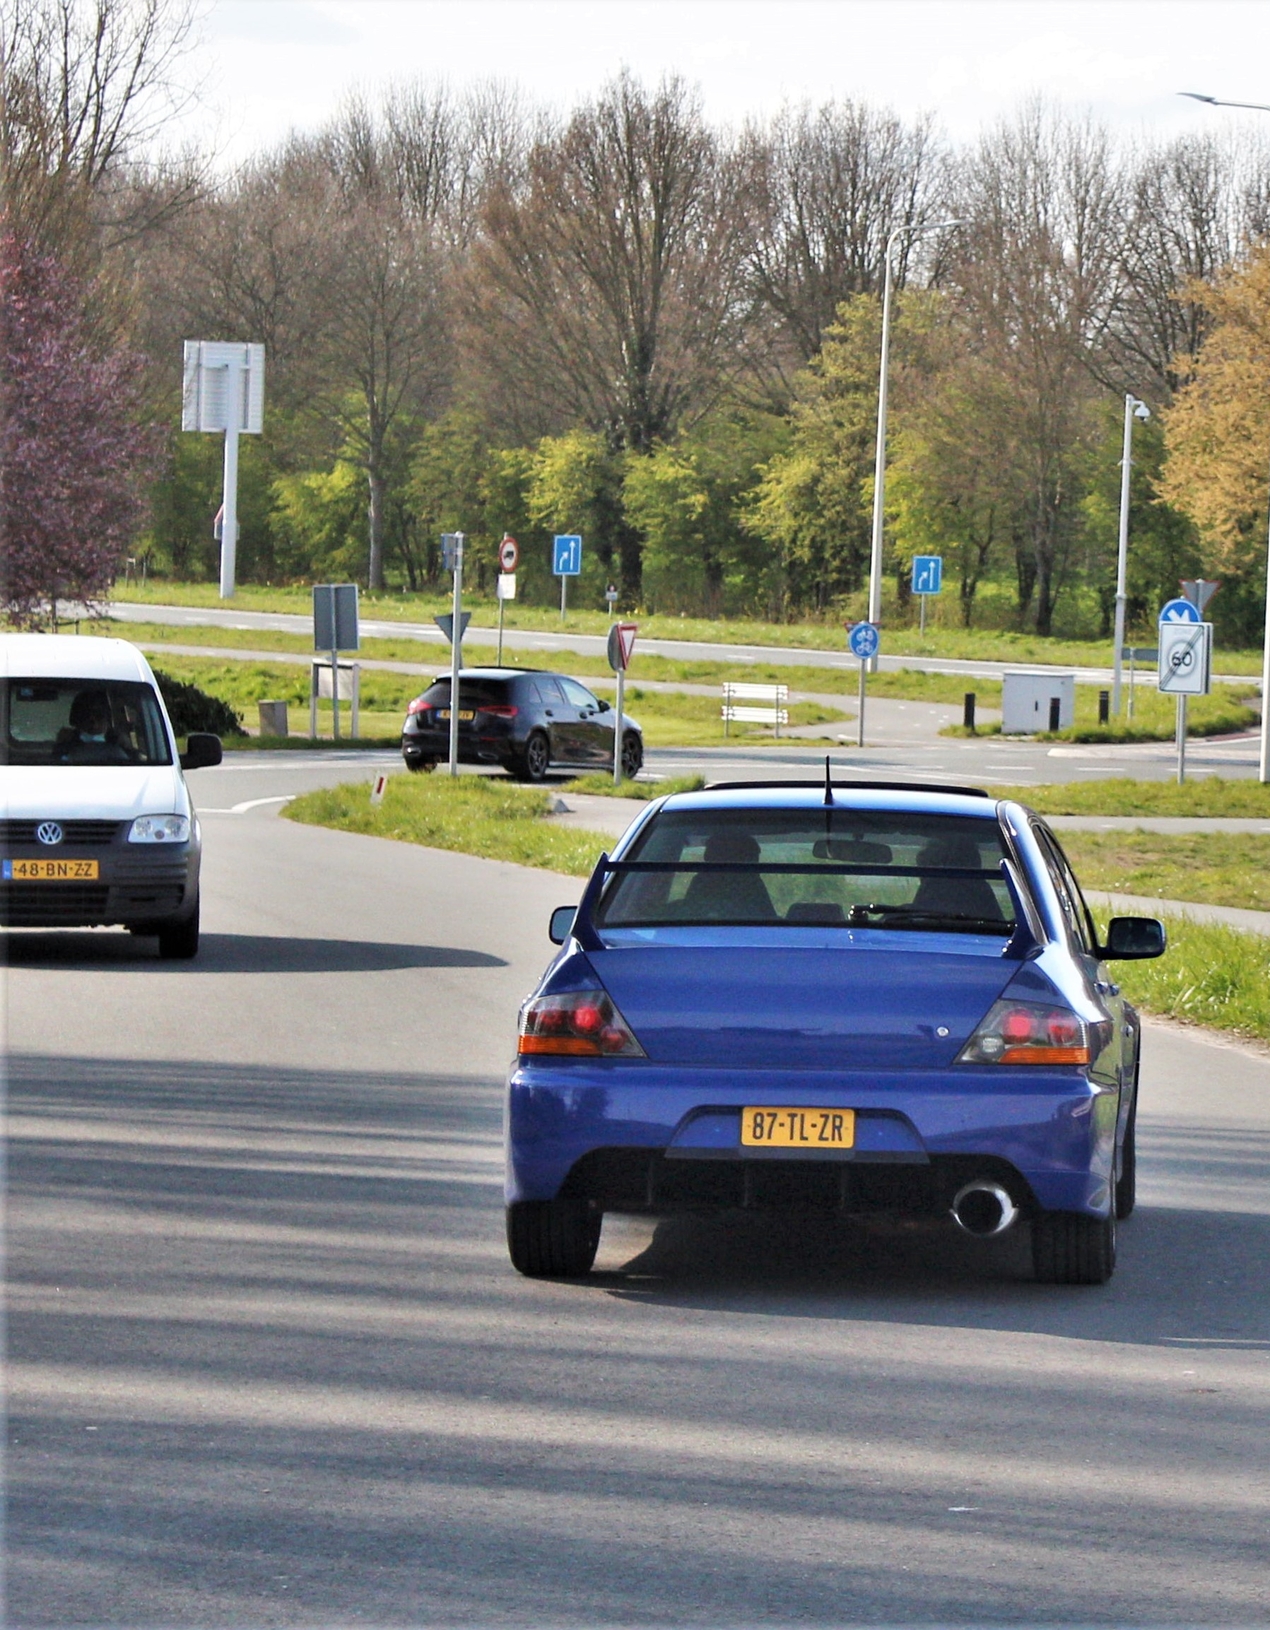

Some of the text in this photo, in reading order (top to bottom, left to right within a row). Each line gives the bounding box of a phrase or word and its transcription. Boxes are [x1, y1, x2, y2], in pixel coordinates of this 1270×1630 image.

[1172, 651, 1192, 666] 60
[18, 862, 93, 877] 48-BN-ZZ
[752, 1112, 844, 1142] 87-TL-ZR
